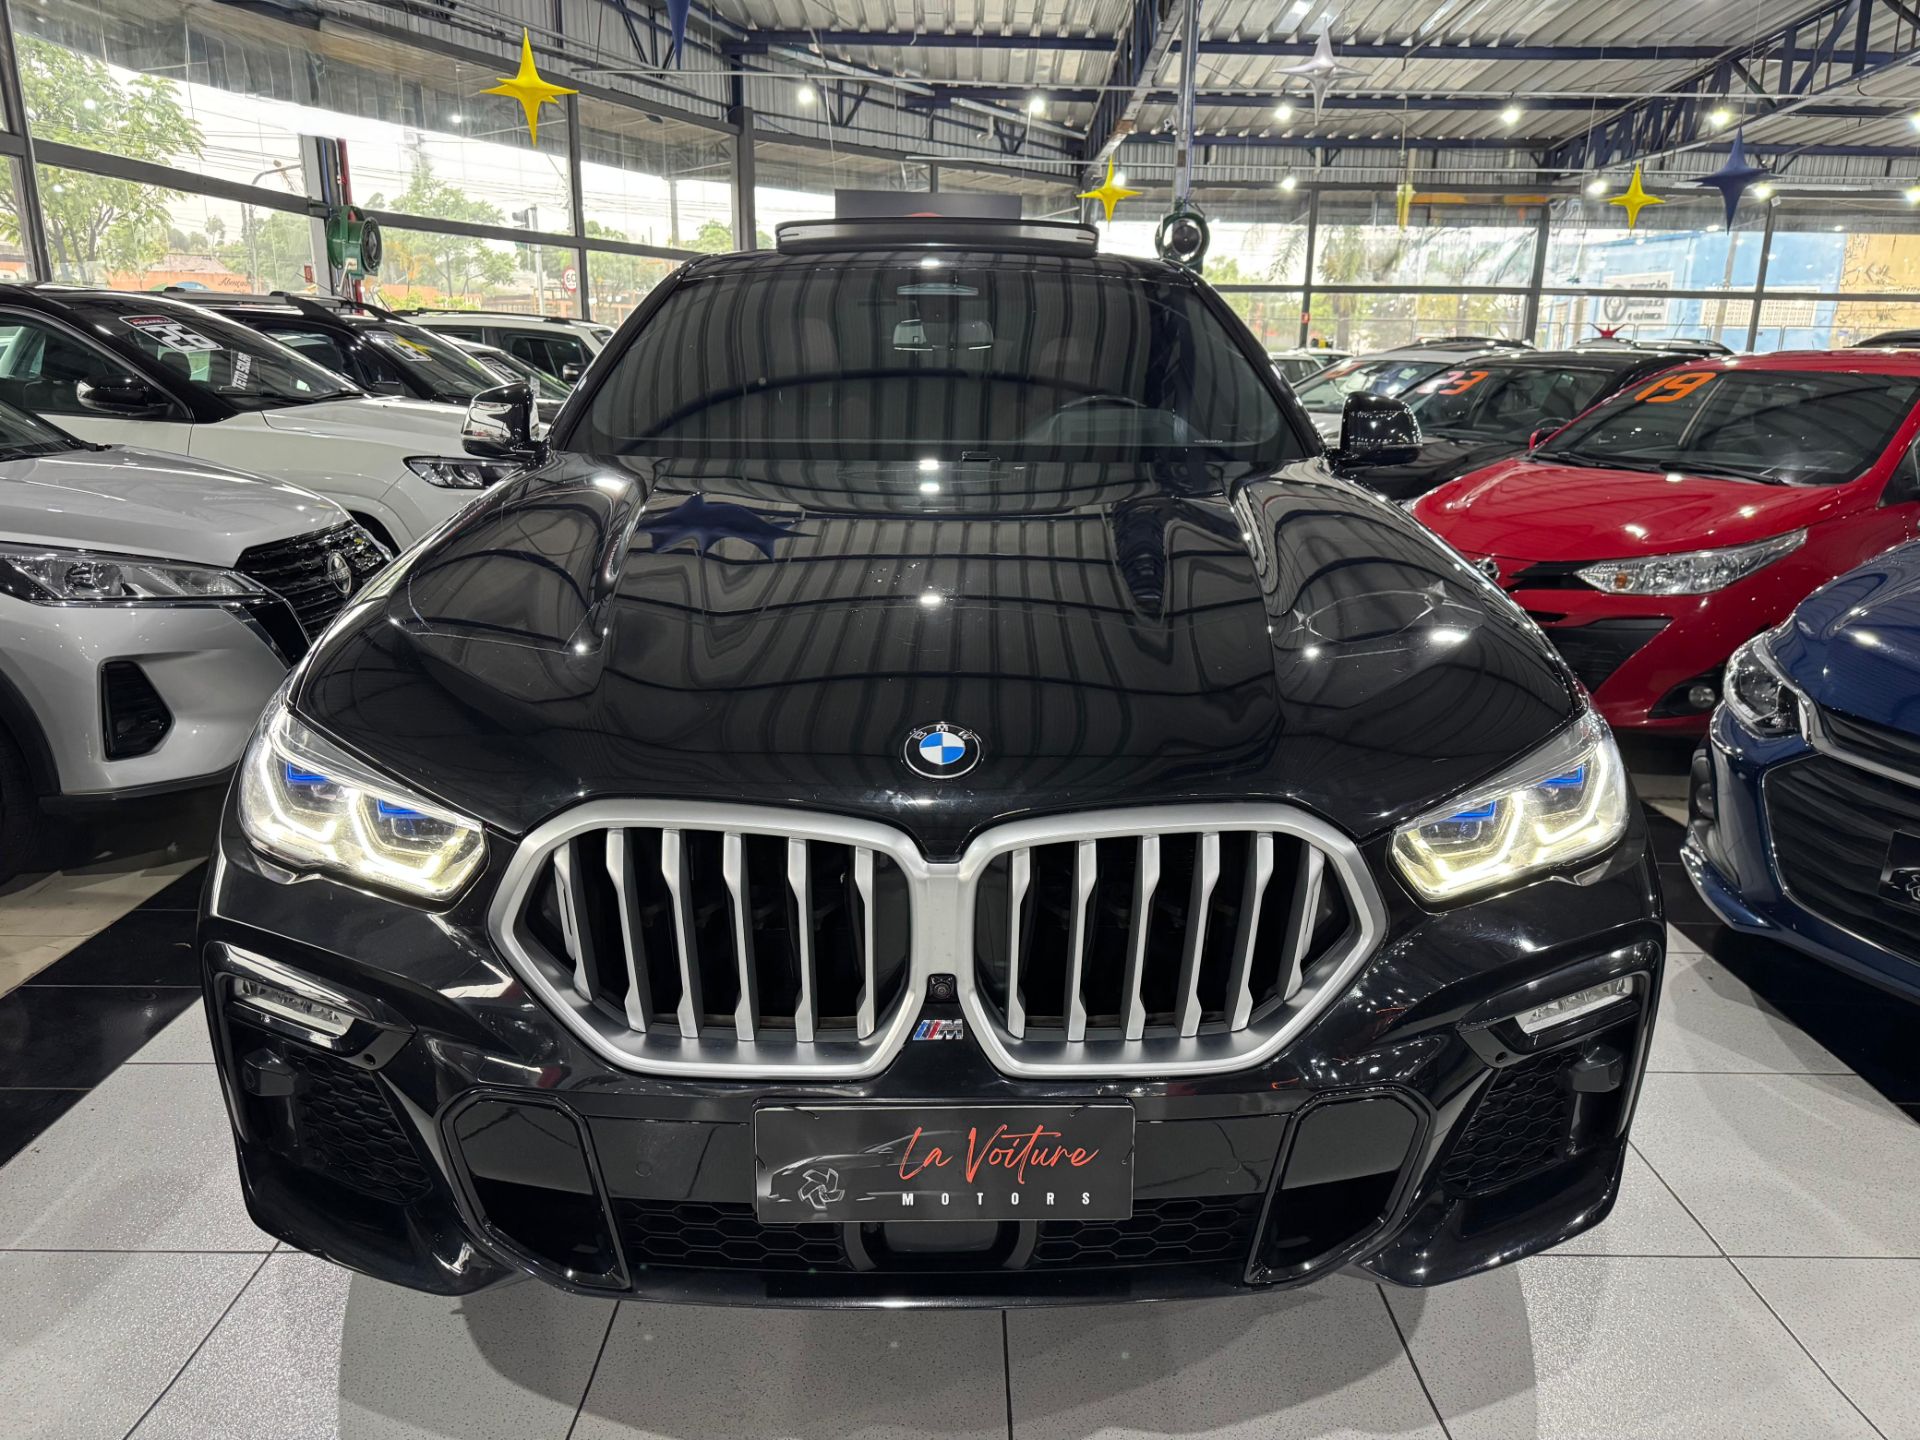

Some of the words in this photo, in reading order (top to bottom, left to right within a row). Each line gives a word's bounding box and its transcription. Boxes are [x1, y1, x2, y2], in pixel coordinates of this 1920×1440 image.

[144, 324, 218, 351] 26
[1416, 370, 1489, 395] 23
[1634, 371, 1717, 403] 19
[911, 723, 973, 741] BMW
[898, 1126, 952, 1181] La
[963, 1123, 1100, 1185] Voiture
[901, 1191, 1092, 1206] MOTORS
